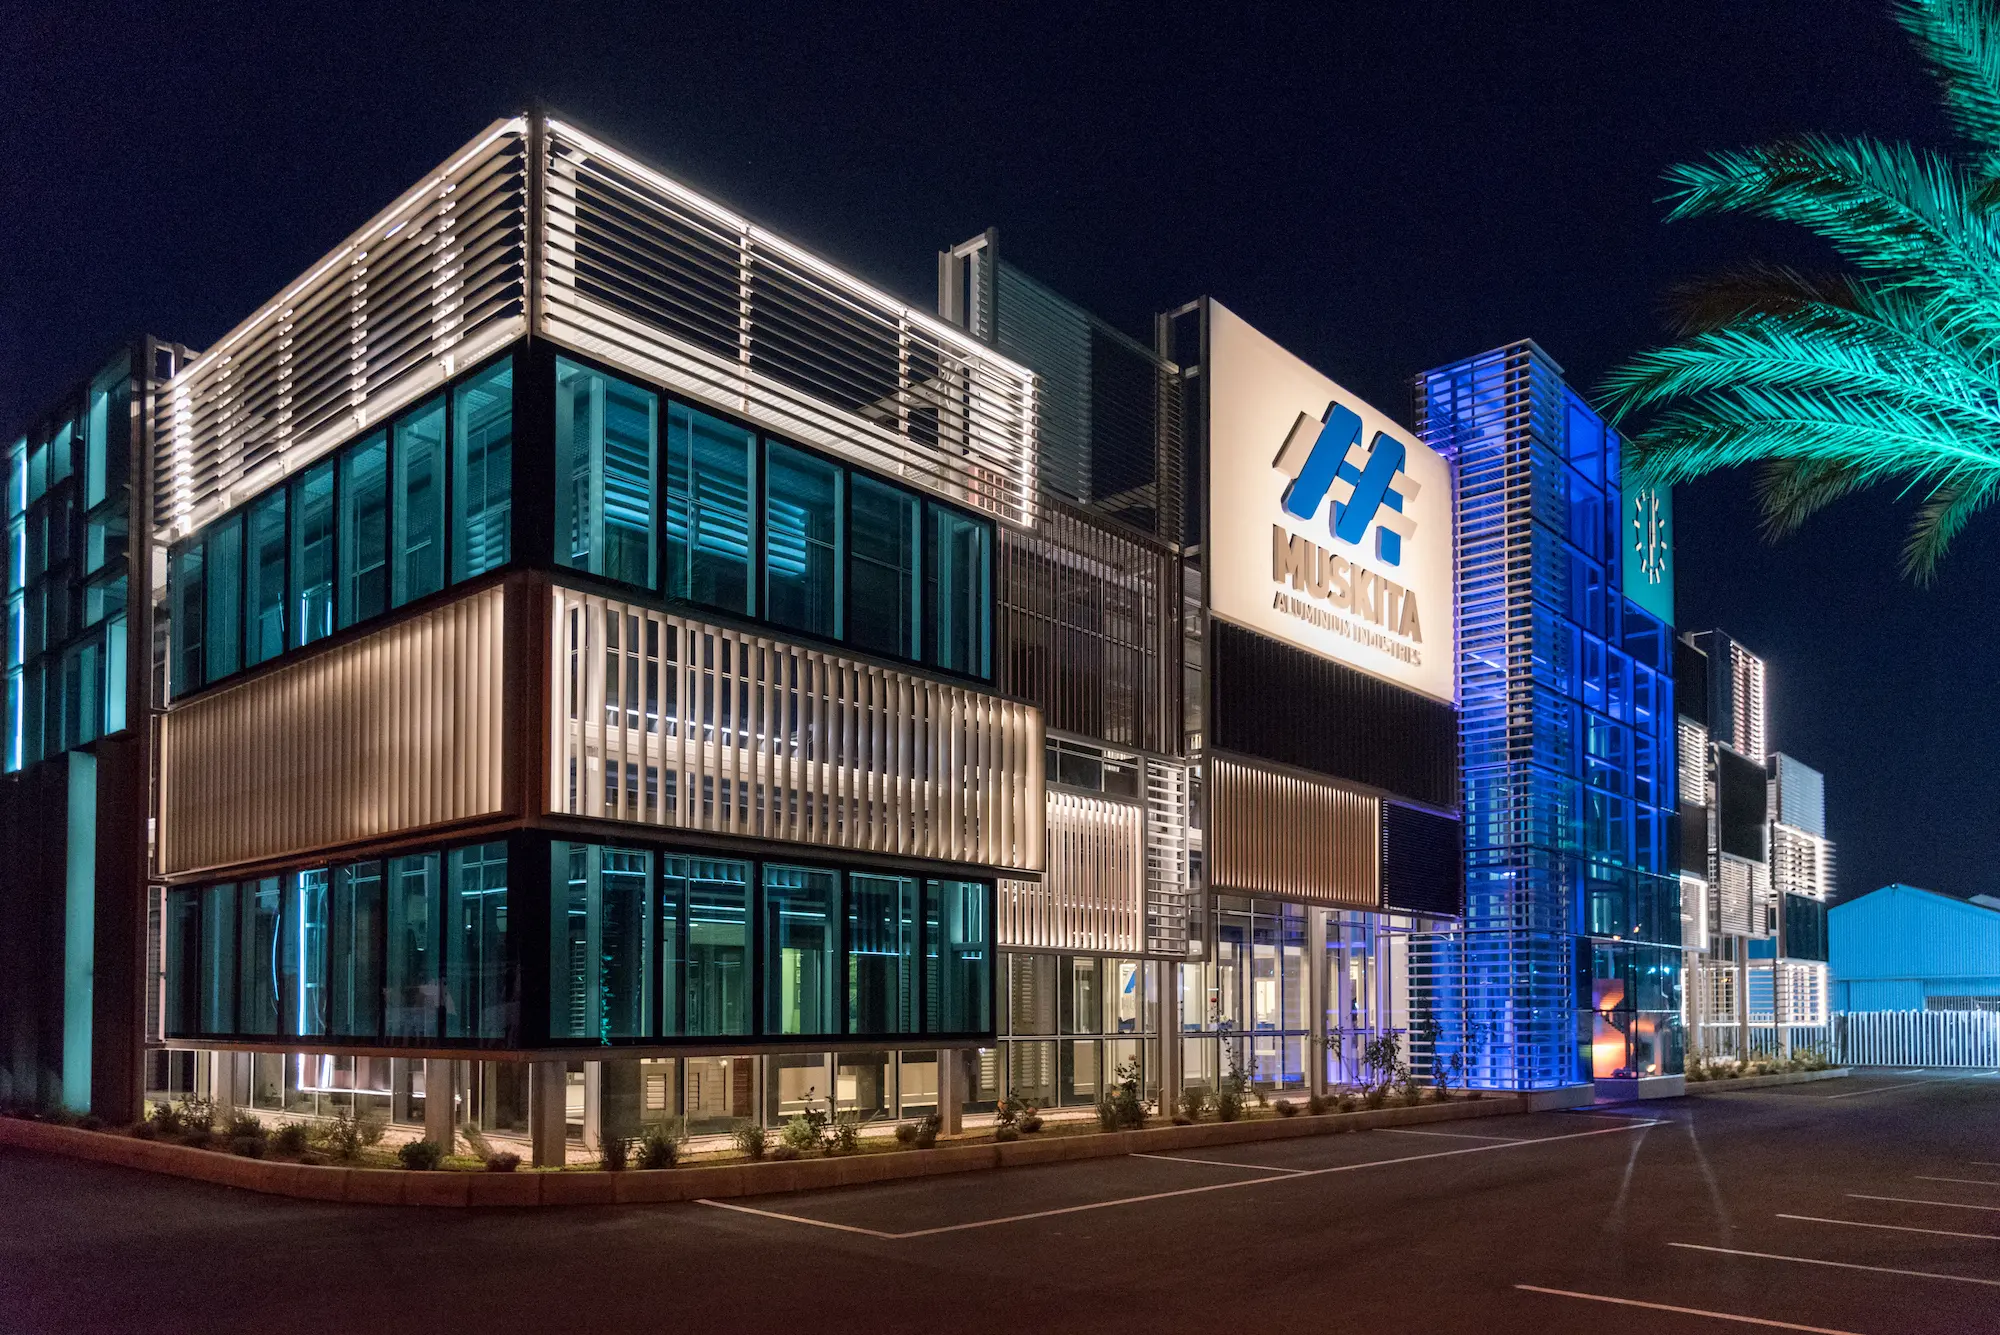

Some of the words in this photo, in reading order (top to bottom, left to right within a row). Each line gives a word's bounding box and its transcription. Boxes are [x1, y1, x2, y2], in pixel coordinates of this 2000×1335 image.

[1273, 523, 1423, 643] MUSKITA
[1273, 591, 1351, 638] ALUMINIUM
[1352, 623, 1422, 667] INDUSTRIES
